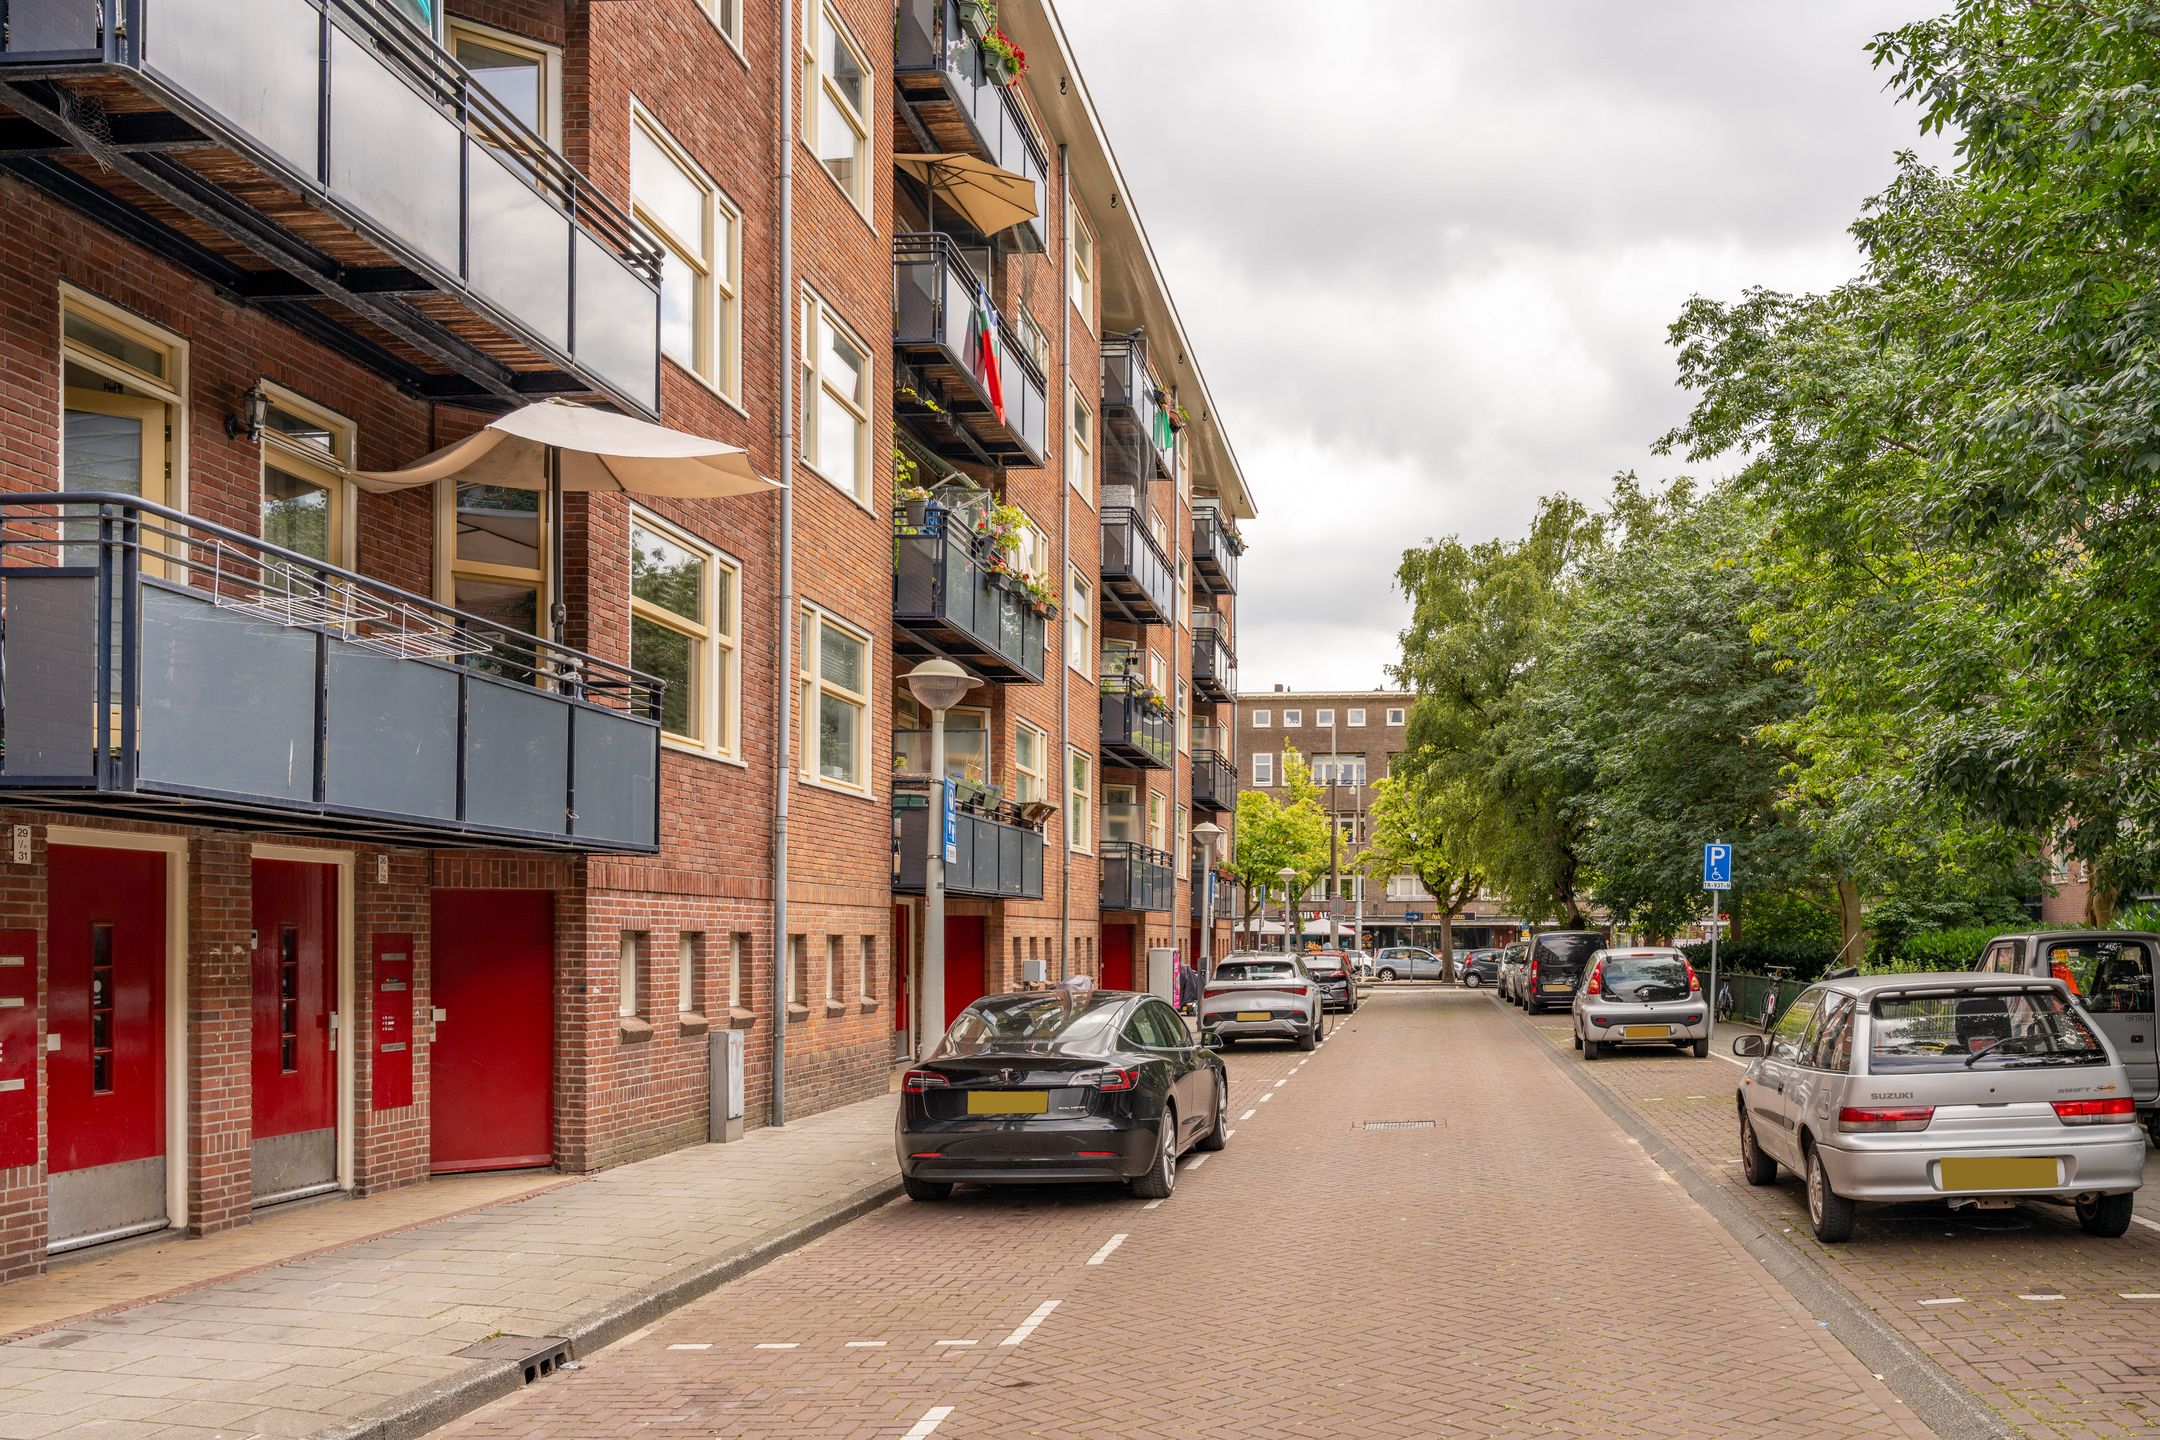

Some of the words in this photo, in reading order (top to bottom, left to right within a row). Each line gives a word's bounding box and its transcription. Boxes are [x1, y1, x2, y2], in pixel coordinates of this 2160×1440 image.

[17, 827, 29, 838] 29
[18, 851, 28, 861] 31
[379, 856, 387, 865] 26
[1710, 846, 1726, 867] P
[1870, 1091, 1914, 1100] SUZUKI
